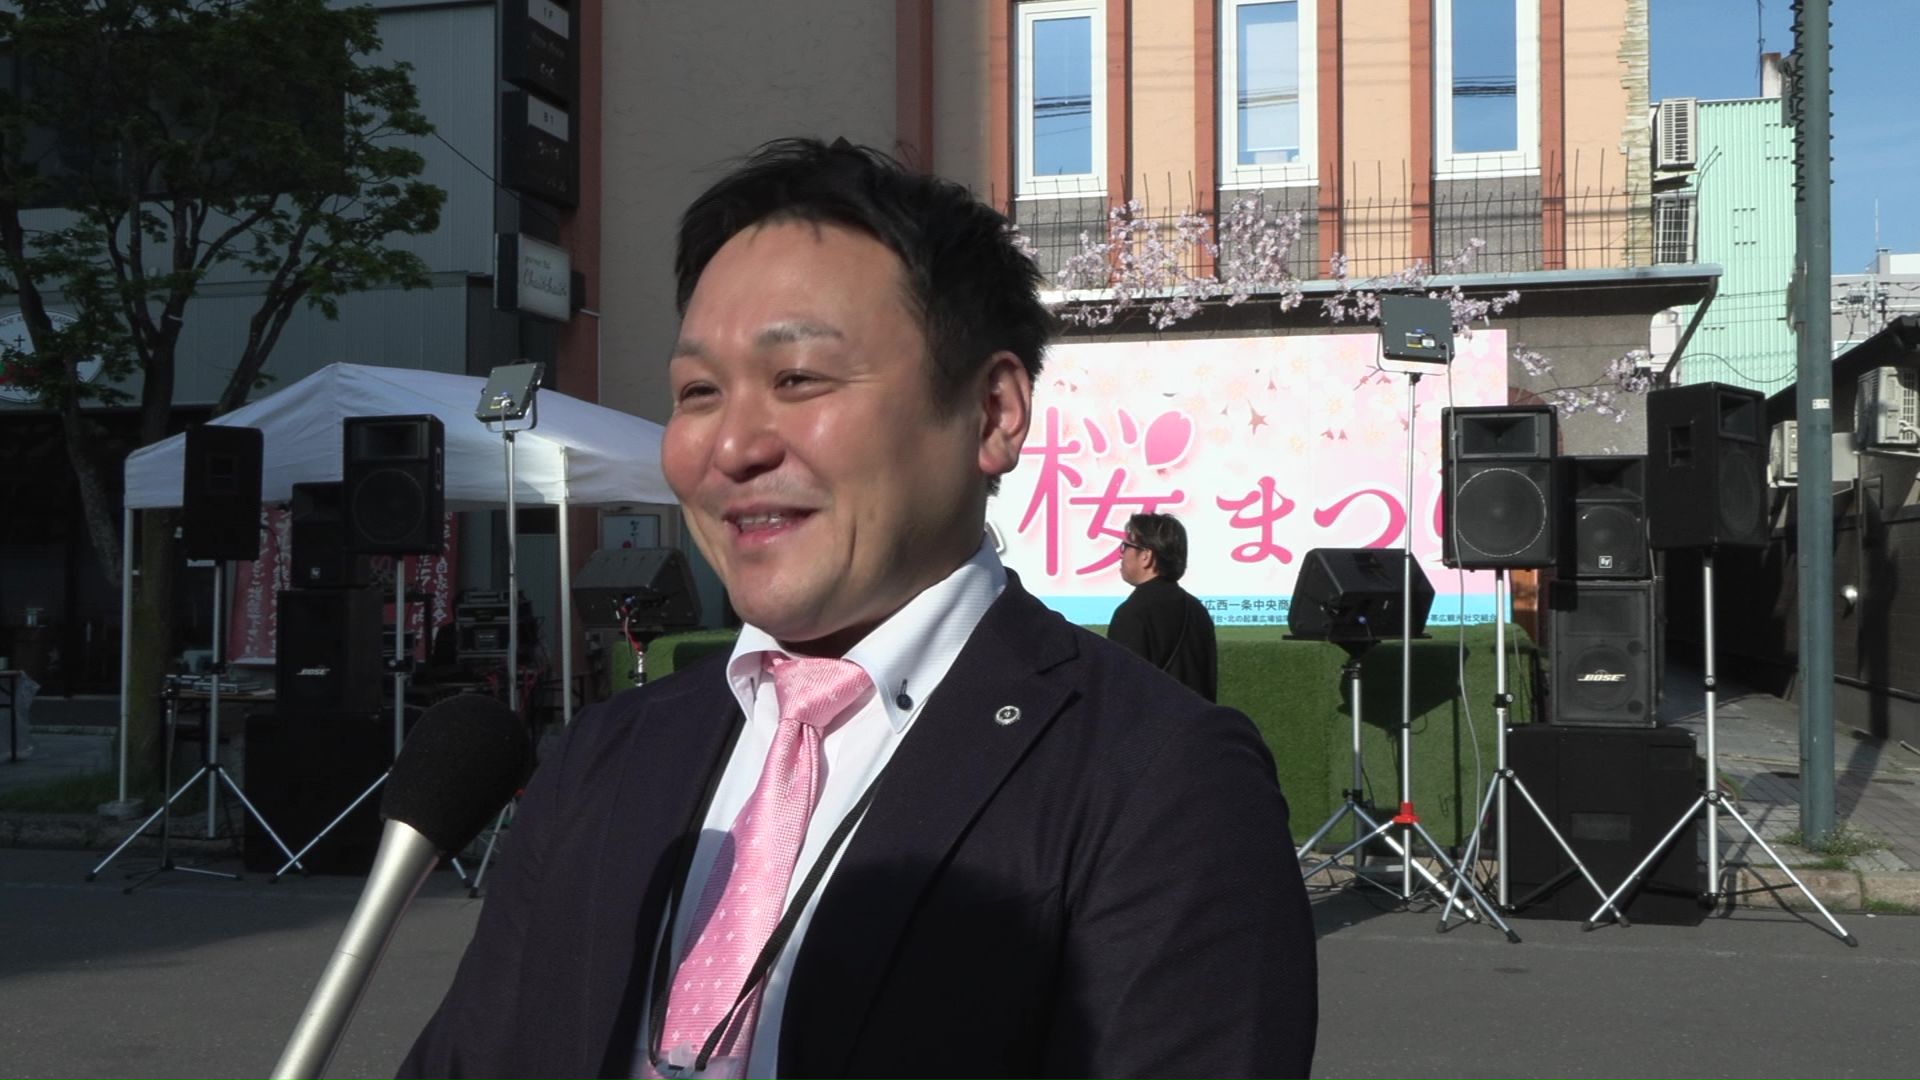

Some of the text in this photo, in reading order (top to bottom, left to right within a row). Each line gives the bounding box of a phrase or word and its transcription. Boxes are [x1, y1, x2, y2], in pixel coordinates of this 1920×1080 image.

[1017, 406, 1443, 578] 桜まつ
[1200, 599, 1289, 611] 広西一条中央商
[1577, 673, 1627, 682] BOSE
